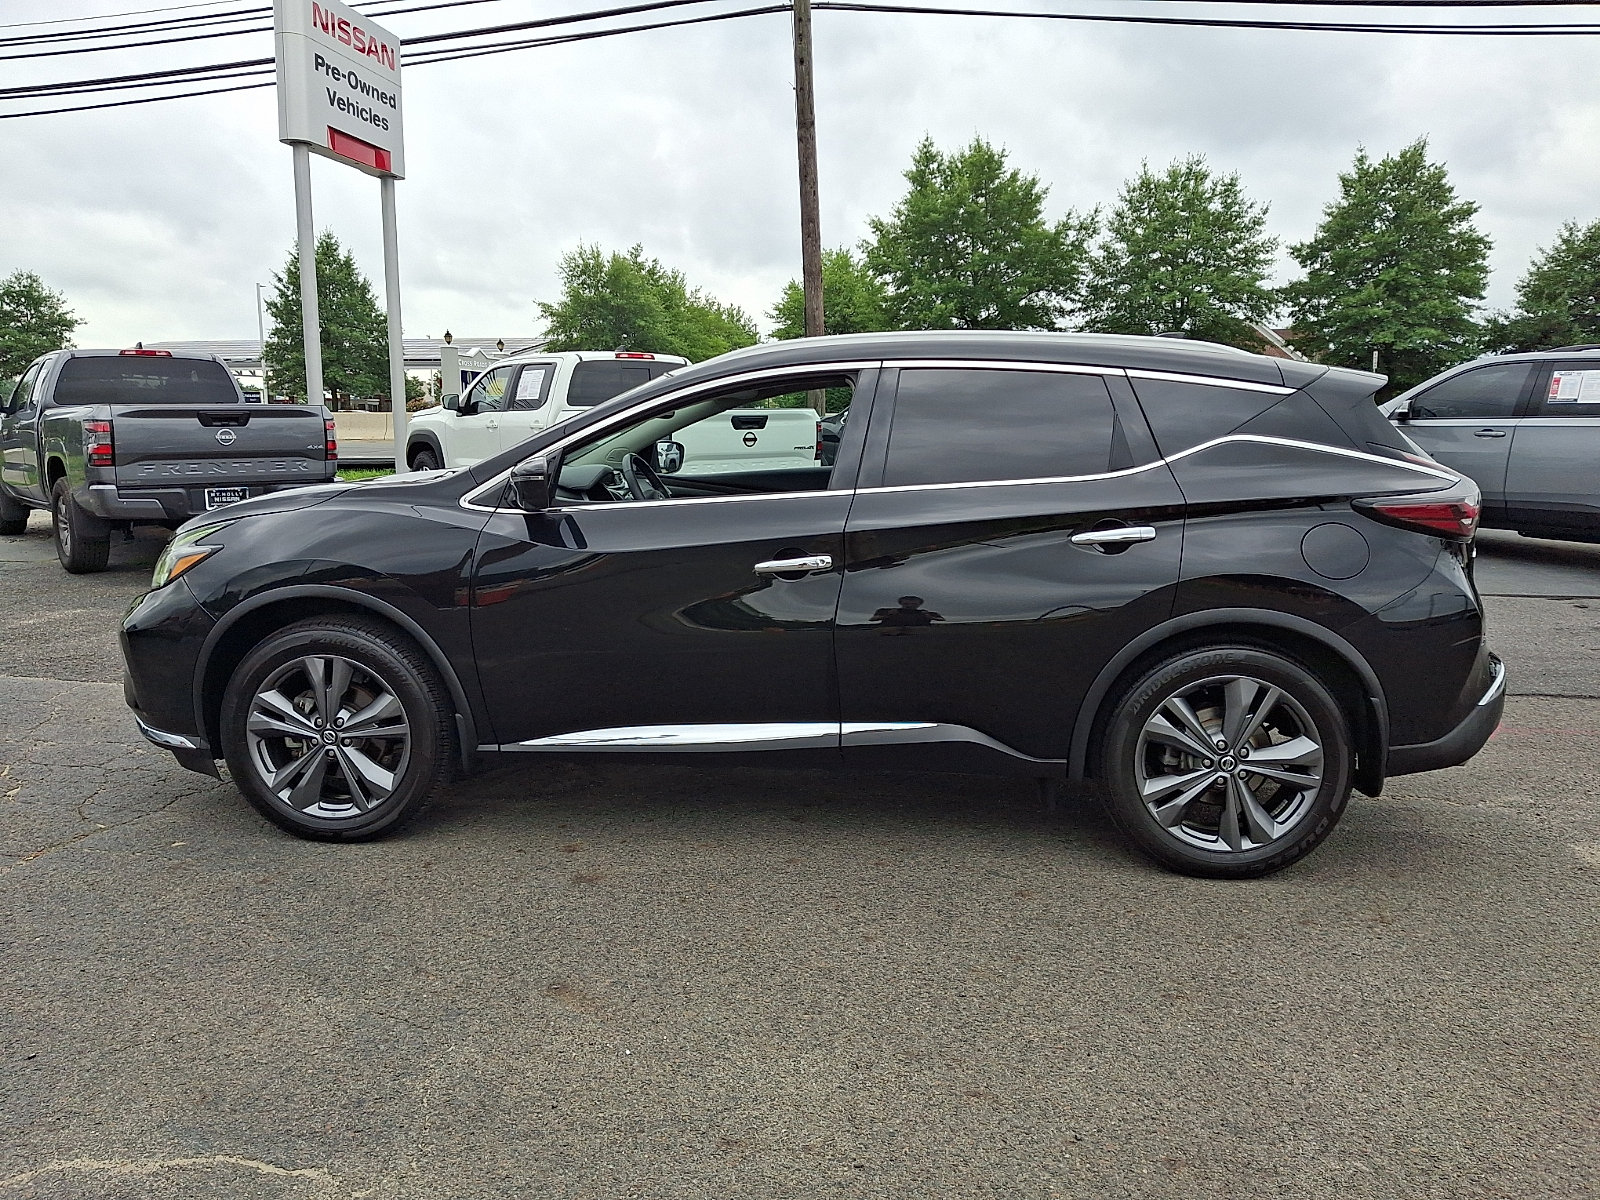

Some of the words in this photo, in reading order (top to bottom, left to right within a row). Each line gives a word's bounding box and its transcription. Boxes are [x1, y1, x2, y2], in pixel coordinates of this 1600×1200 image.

[312, 1, 396, 71] NISSAN
[314, 53, 397, 110] Pre-Owned
[325, 87, 389, 131] Vehicles
[138, 459, 309, 476] FRONTIER
